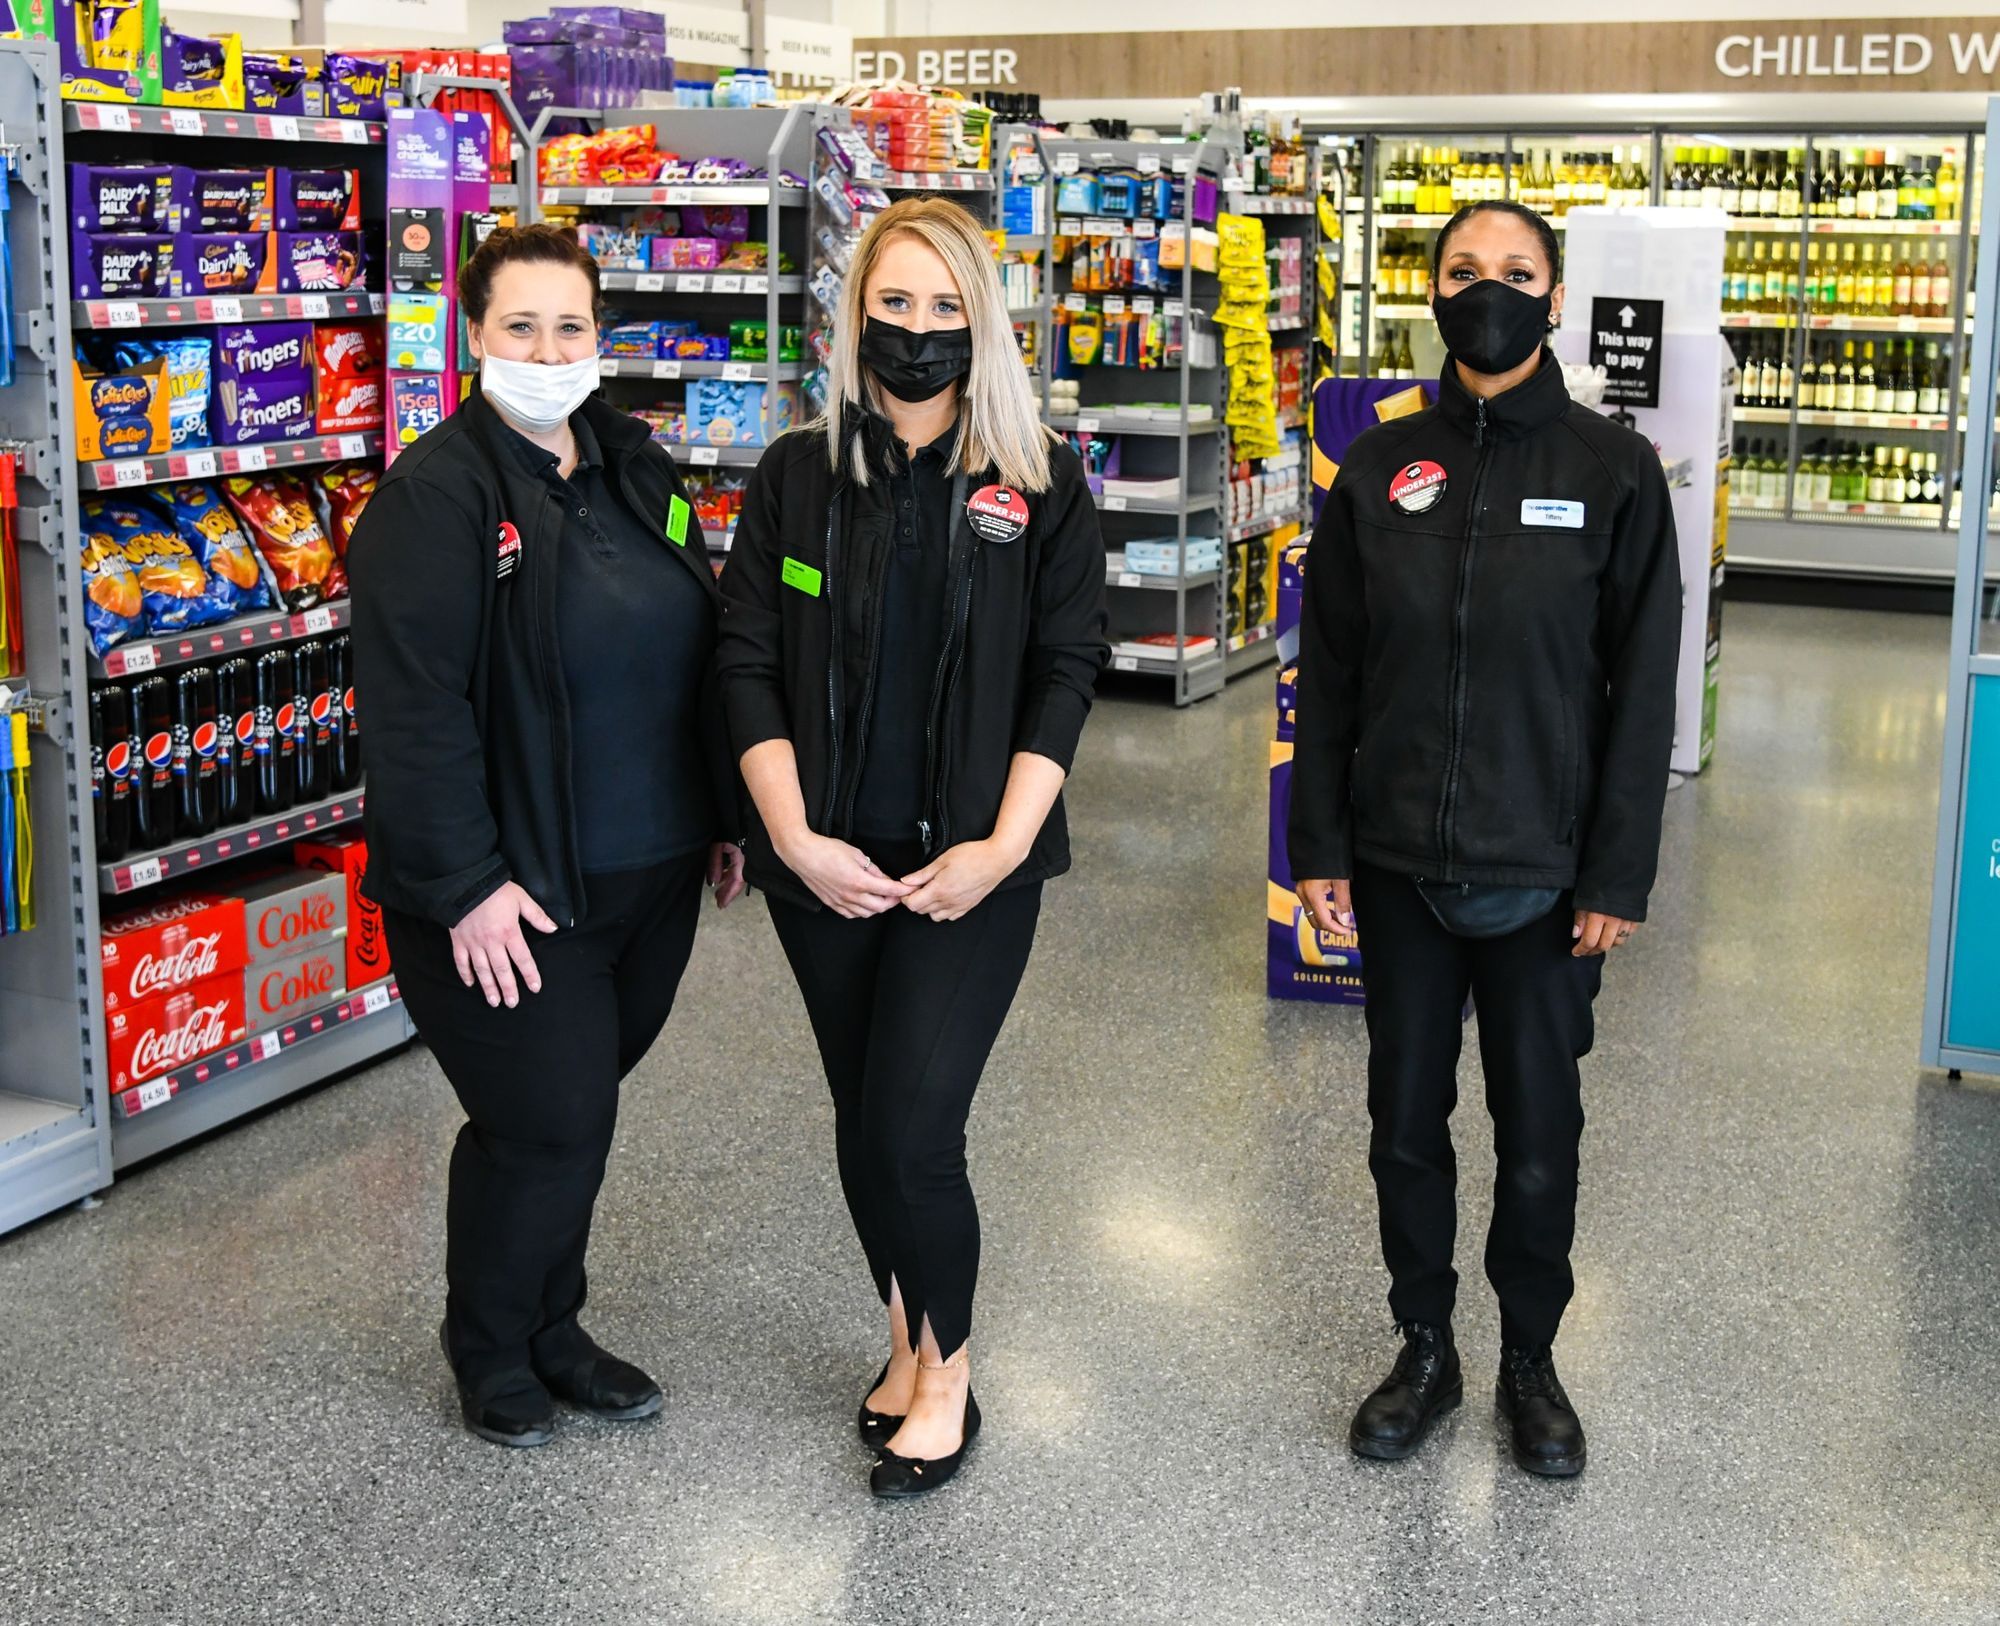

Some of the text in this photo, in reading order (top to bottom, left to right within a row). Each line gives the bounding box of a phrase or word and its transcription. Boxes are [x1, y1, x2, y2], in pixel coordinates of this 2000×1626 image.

[147, 52, 158, 71] 4
[1715, 33, 1933, 77] CHILLED
[917, 48, 1018, 85] BEER
[114, 113, 125, 126] £1
[100, 187, 136, 201] DAIRY
[99, 201, 130, 215] MILK
[102, 255, 139, 269] DAIRY
[198, 242, 255, 276] Dairy Milk
[101, 269, 131, 282] MILK
[215, 305, 238, 317] £1.50
[304, 303, 325, 314] £1.50
[111, 311, 135, 323] £1.50
[392, 322, 436, 343] £20
[1597, 331, 1653, 351] This way
[236, 338, 300, 374] fingers
[1605, 351, 1645, 370] to pay
[397, 394, 438, 410] 15GB
[240, 396, 302, 427] fingers
[406, 408, 440, 427] £15
[285, 420, 311, 437] fingers
[353, 442, 362, 453] £1
[201, 461, 212, 472] £1
[252, 454, 263, 465] £1
[118, 470, 142, 482] £1.50
[1393, 479, 1425, 499] UNDER
[1426, 471, 1443, 485] 25?
[974, 500, 1026, 523] UNDER 25?
[308, 616, 328, 628] £1.25
[127, 654, 151, 669] £1.25
[134, 867, 157, 882] £1.50
[257, 897, 336, 949] Coke
[103, 942, 117, 957] 10
[129, 931, 223, 999] Coca-Cola
[1293, 971, 1363, 987] GOLDEN CARA
[259, 961, 335, 1015] Coke
[112, 1013, 126, 1028] 10
[130, 999, 230, 1080] Coca-Cola
[142, 1086, 166, 1104] £4.50
